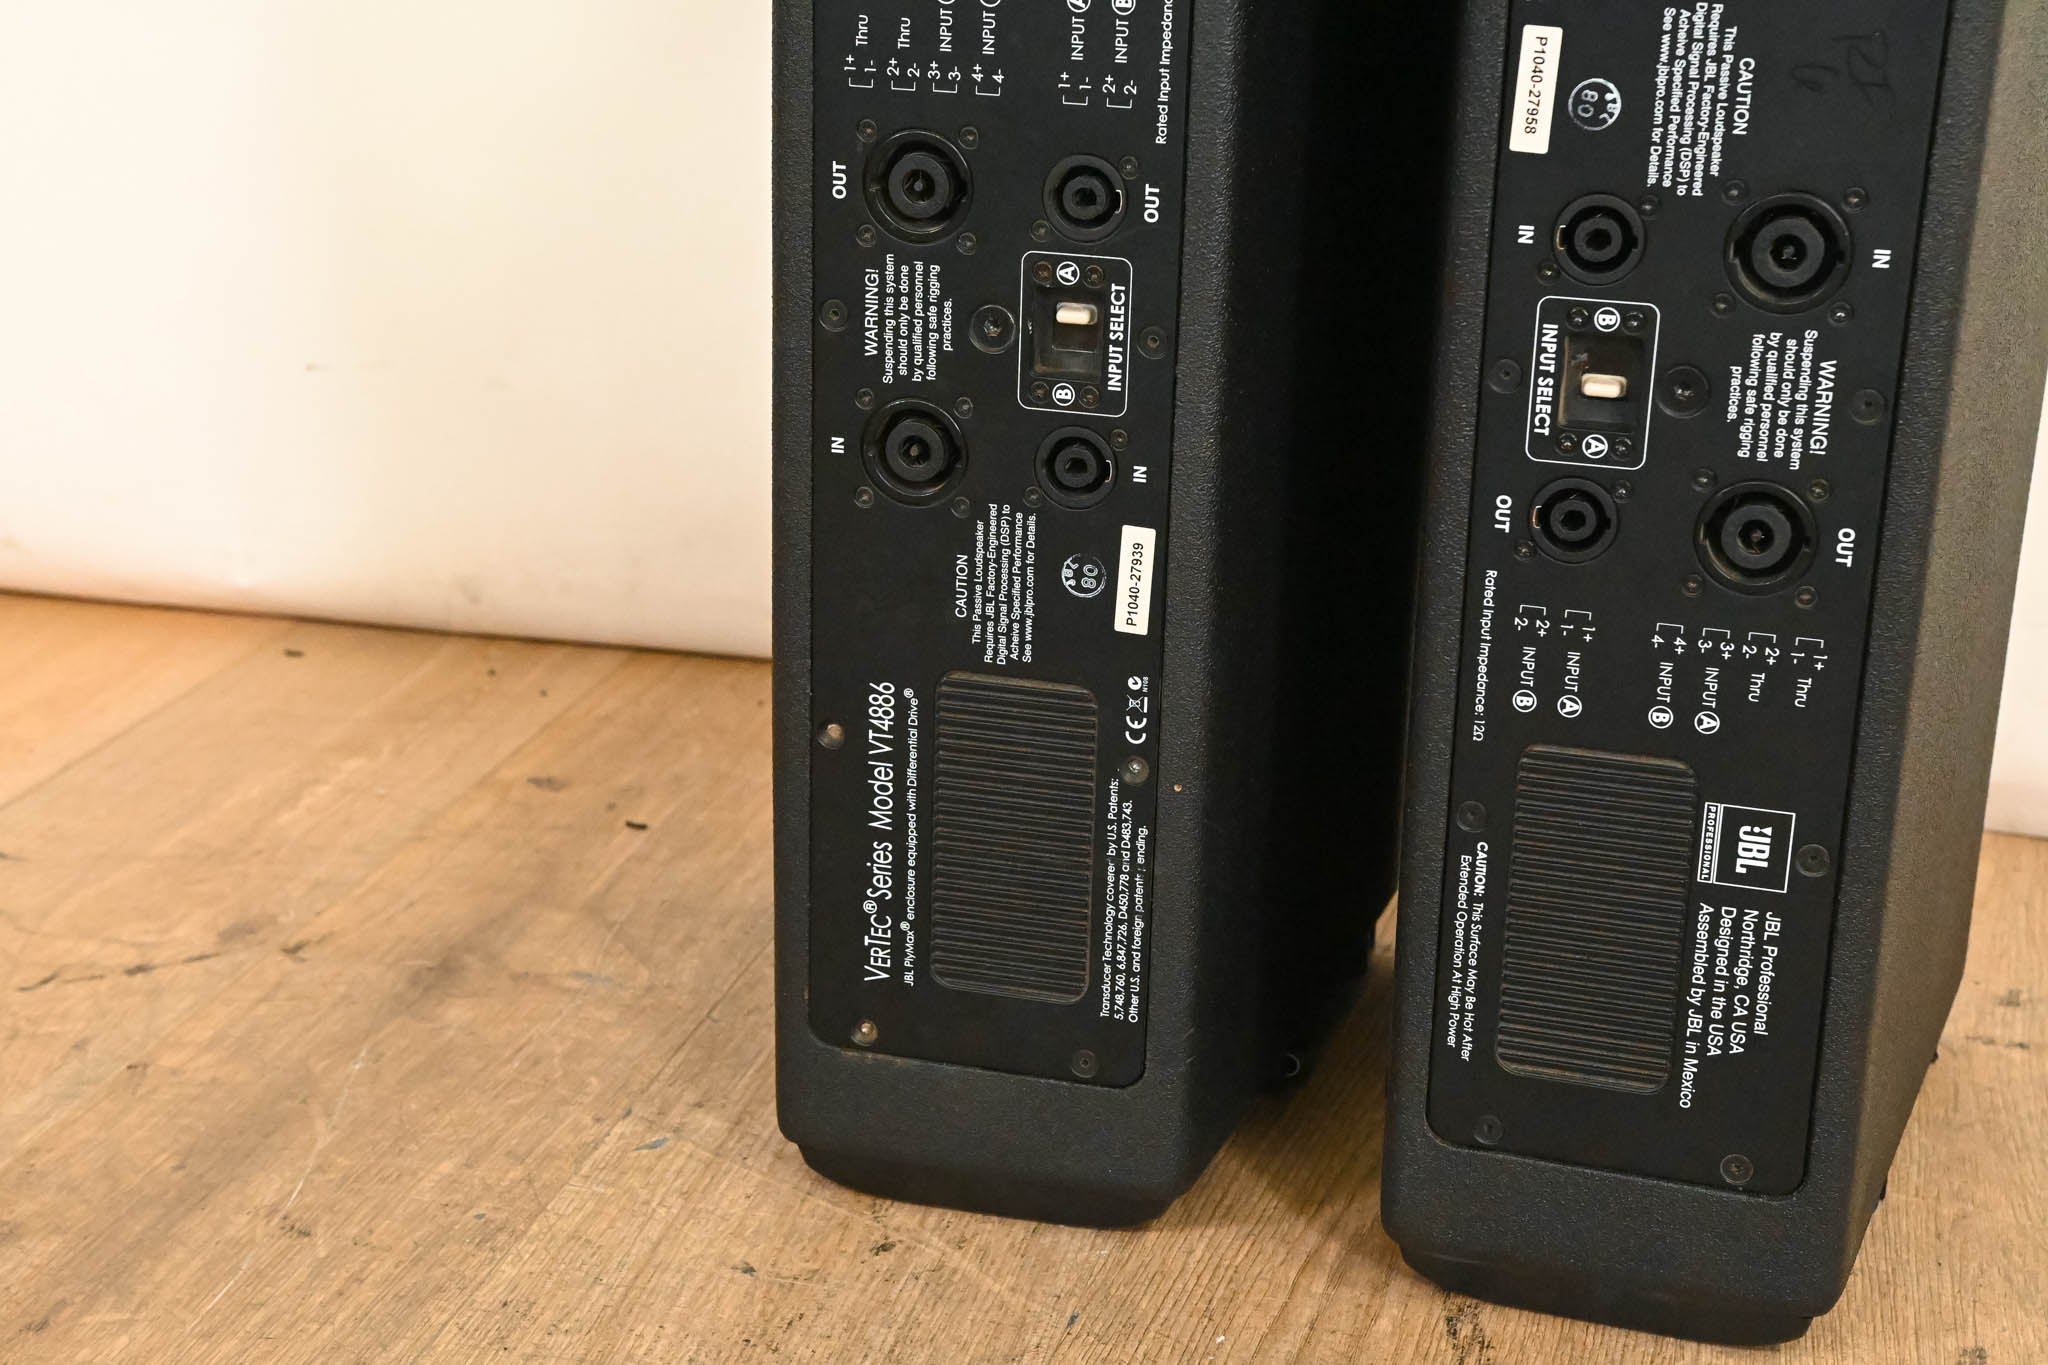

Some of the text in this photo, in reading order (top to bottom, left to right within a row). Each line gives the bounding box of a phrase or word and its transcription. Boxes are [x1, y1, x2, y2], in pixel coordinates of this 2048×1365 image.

[855, 14, 869, 46] Thru
[897, 17, 911, 49] Thru
[939, 8, 953, 52] INPUT
[982, 10, 996, 55] INPUT
[1070, 15, 1086, 61] INPUT
[1114, 18, 1129, 64] INPUT
[1156, 68, 1172, 144] Rated Input
[1524, 36, 1548, 135] P1040-27958
[1646, 6, 1676, 188] See www.jblpro.com for Details.
[1662, 8, 1692, 188] Acheive Specified Performance
[1676, 2, 1708, 196] Digital Signal Processing (DSP) to
[1692, 4, 1724, 196] Requires JBL Factory-Engineered
[1710, 26, 1738, 176] This Passive Loudspeaker
[1732, 58, 1756, 134] CAUTION
[832, 161, 847, 199] OUT
[1144, 184, 1160, 223] OUT
[1517, 224, 1535, 245] IN
[1871, 249, 1892, 269] IN
[864, 268, 880, 356] WARNING!
[882, 254, 896, 384] Suspending this system
[896, 264, 910, 376] should only be done
[912, 260, 926, 382] by qualified personnel
[926, 264, 940, 380] following safe rigging
[942, 298, 954, 352] practices.
[1108, 282, 1126, 392] INPUT SELECT
[1534, 324, 1558, 436] INPUT SELECT
[1726, 366, 1742, 422] practices.
[1736, 334, 1766, 458] following safe rigging
[1756, 332, 1782, 462] by qualified personnel
[1774, 338, 1798, 458] should only be done
[1788, 330, 1818, 470] Suspending this system
[1808, 360, 1836, 454] WARNING!
[831, 436, 845, 454] IN
[1133, 465, 1147, 483] IN
[1494, 494, 1512, 533] OUT
[1835, 527, 1855, 568] OUT
[954, 554, 968, 618] CAUTION
[972, 520, 986, 644] This Passive Loudspeaker
[984, 504, 998, 664] Requires JBL Factory-Engineered
[996, 504, 1012, 666] Digital Signal Processing (DSP) to
[1010, 512, 1024, 660] Acheive Specified Performance
[1022, 512, 1036, 662] See www.jblpro.com for Details.
[1126, 542, 1144, 627] P1040-27939
[1474, 570, 1498, 716] Rated Input Impedance:
[1520, 646, 1537, 687] INPUT
[1564, 651, 1581, 692] INPUT
[868, 682, 896, 754] VT4886
[1656, 661, 1674, 703] INPUT
[1701, 666, 1720, 708] INPUT
[1748, 672, 1765, 702] Thru
[1794, 677, 1812, 708] Thru
[868, 760, 894, 830] Model
[906, 728, 918, 786] Differential
[906, 788, 916, 810] with
[866, 840, 892, 900] Series
[906, 812, 918, 866] equipped
[1700, 806, 1717, 880] PROFESSIONAL
[1735, 826, 1773, 874] JBL
[904, 868, 916, 920] enclosure
[1100, 778, 1118, 1016] Transducer Technology by U.S. Patents:
[1114, 800, 1132, 1020] 5,748,760, 6,847,726, D450,778 D483,743.
[904, 970, 914, 986] JBL
[1128, 950, 1142, 1022] Other U.S. and
[1446, 854, 1472, 1048] Extended Operation At High Power
[1460, 842, 1488, 1062] CAUTION: This Surface May Be Hot After
[1706, 906, 1736, 1056] Designed in the USA
[1728, 910, 1760, 1054] Northridge, CA USA
[1754, 912, 1782, 1036] JBL Professional
[1680, 902, 1714, 1108] Assembled by JBL in Mexico
